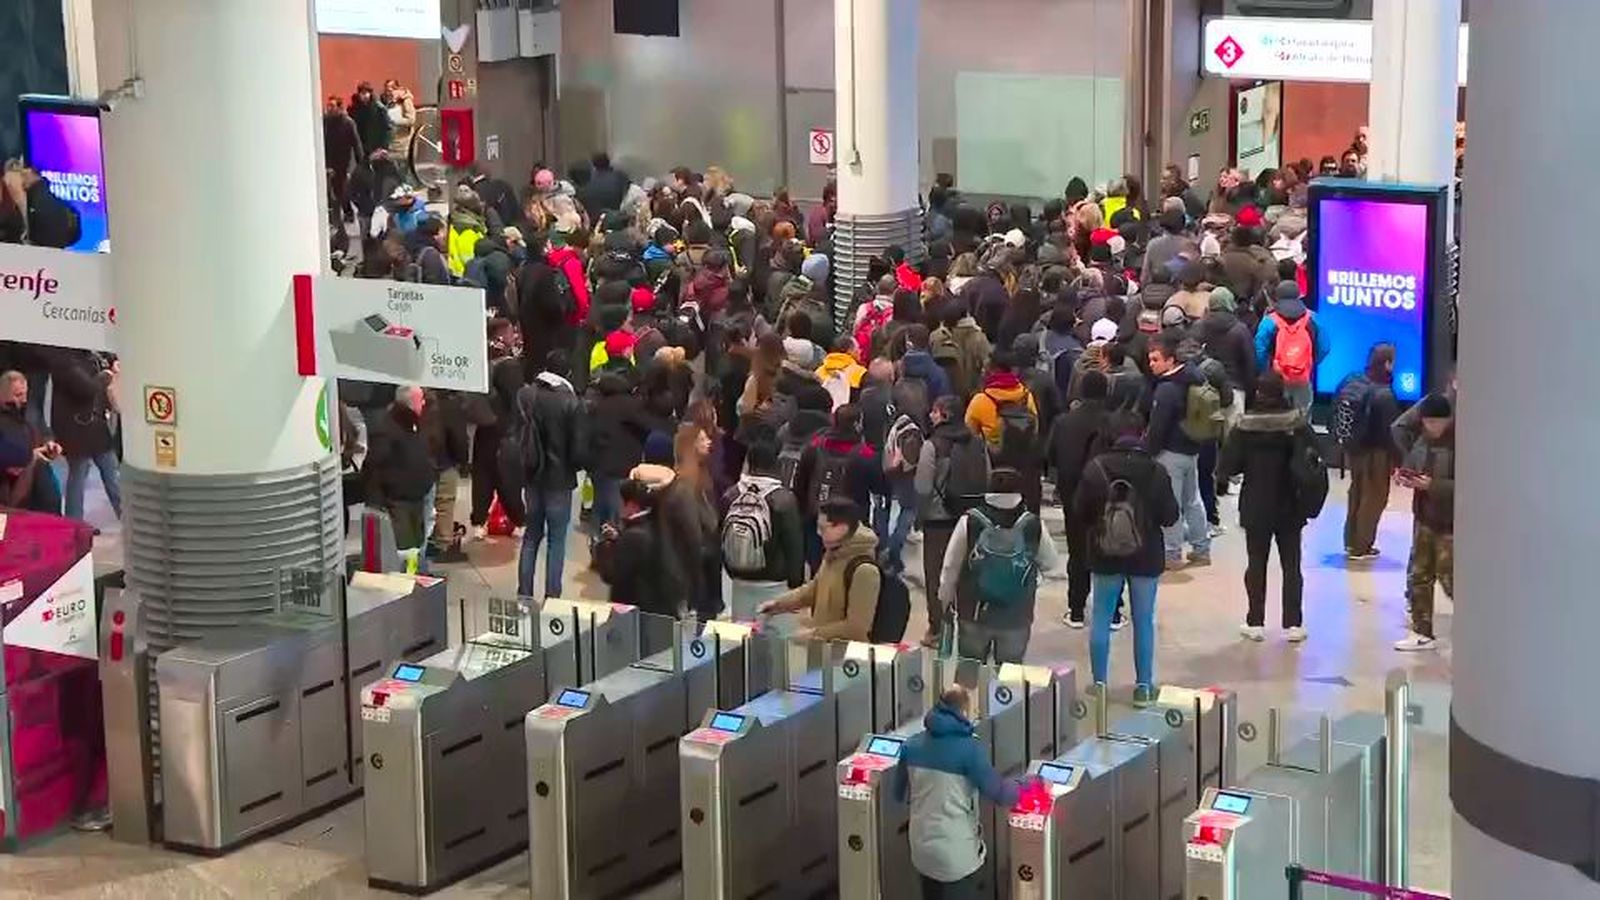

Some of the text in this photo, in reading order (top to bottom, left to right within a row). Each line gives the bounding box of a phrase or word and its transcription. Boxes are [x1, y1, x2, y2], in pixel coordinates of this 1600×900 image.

[1222, 41, 1238, 62] 3
[1327, 269, 1416, 290] BRILLEMOS
[386, 287, 425, 301] Tarjetas
[1326, 286, 1416, 311] JUNTOS
[454, 355, 470, 368] QR
[56, 599, 86, 618] EURO
